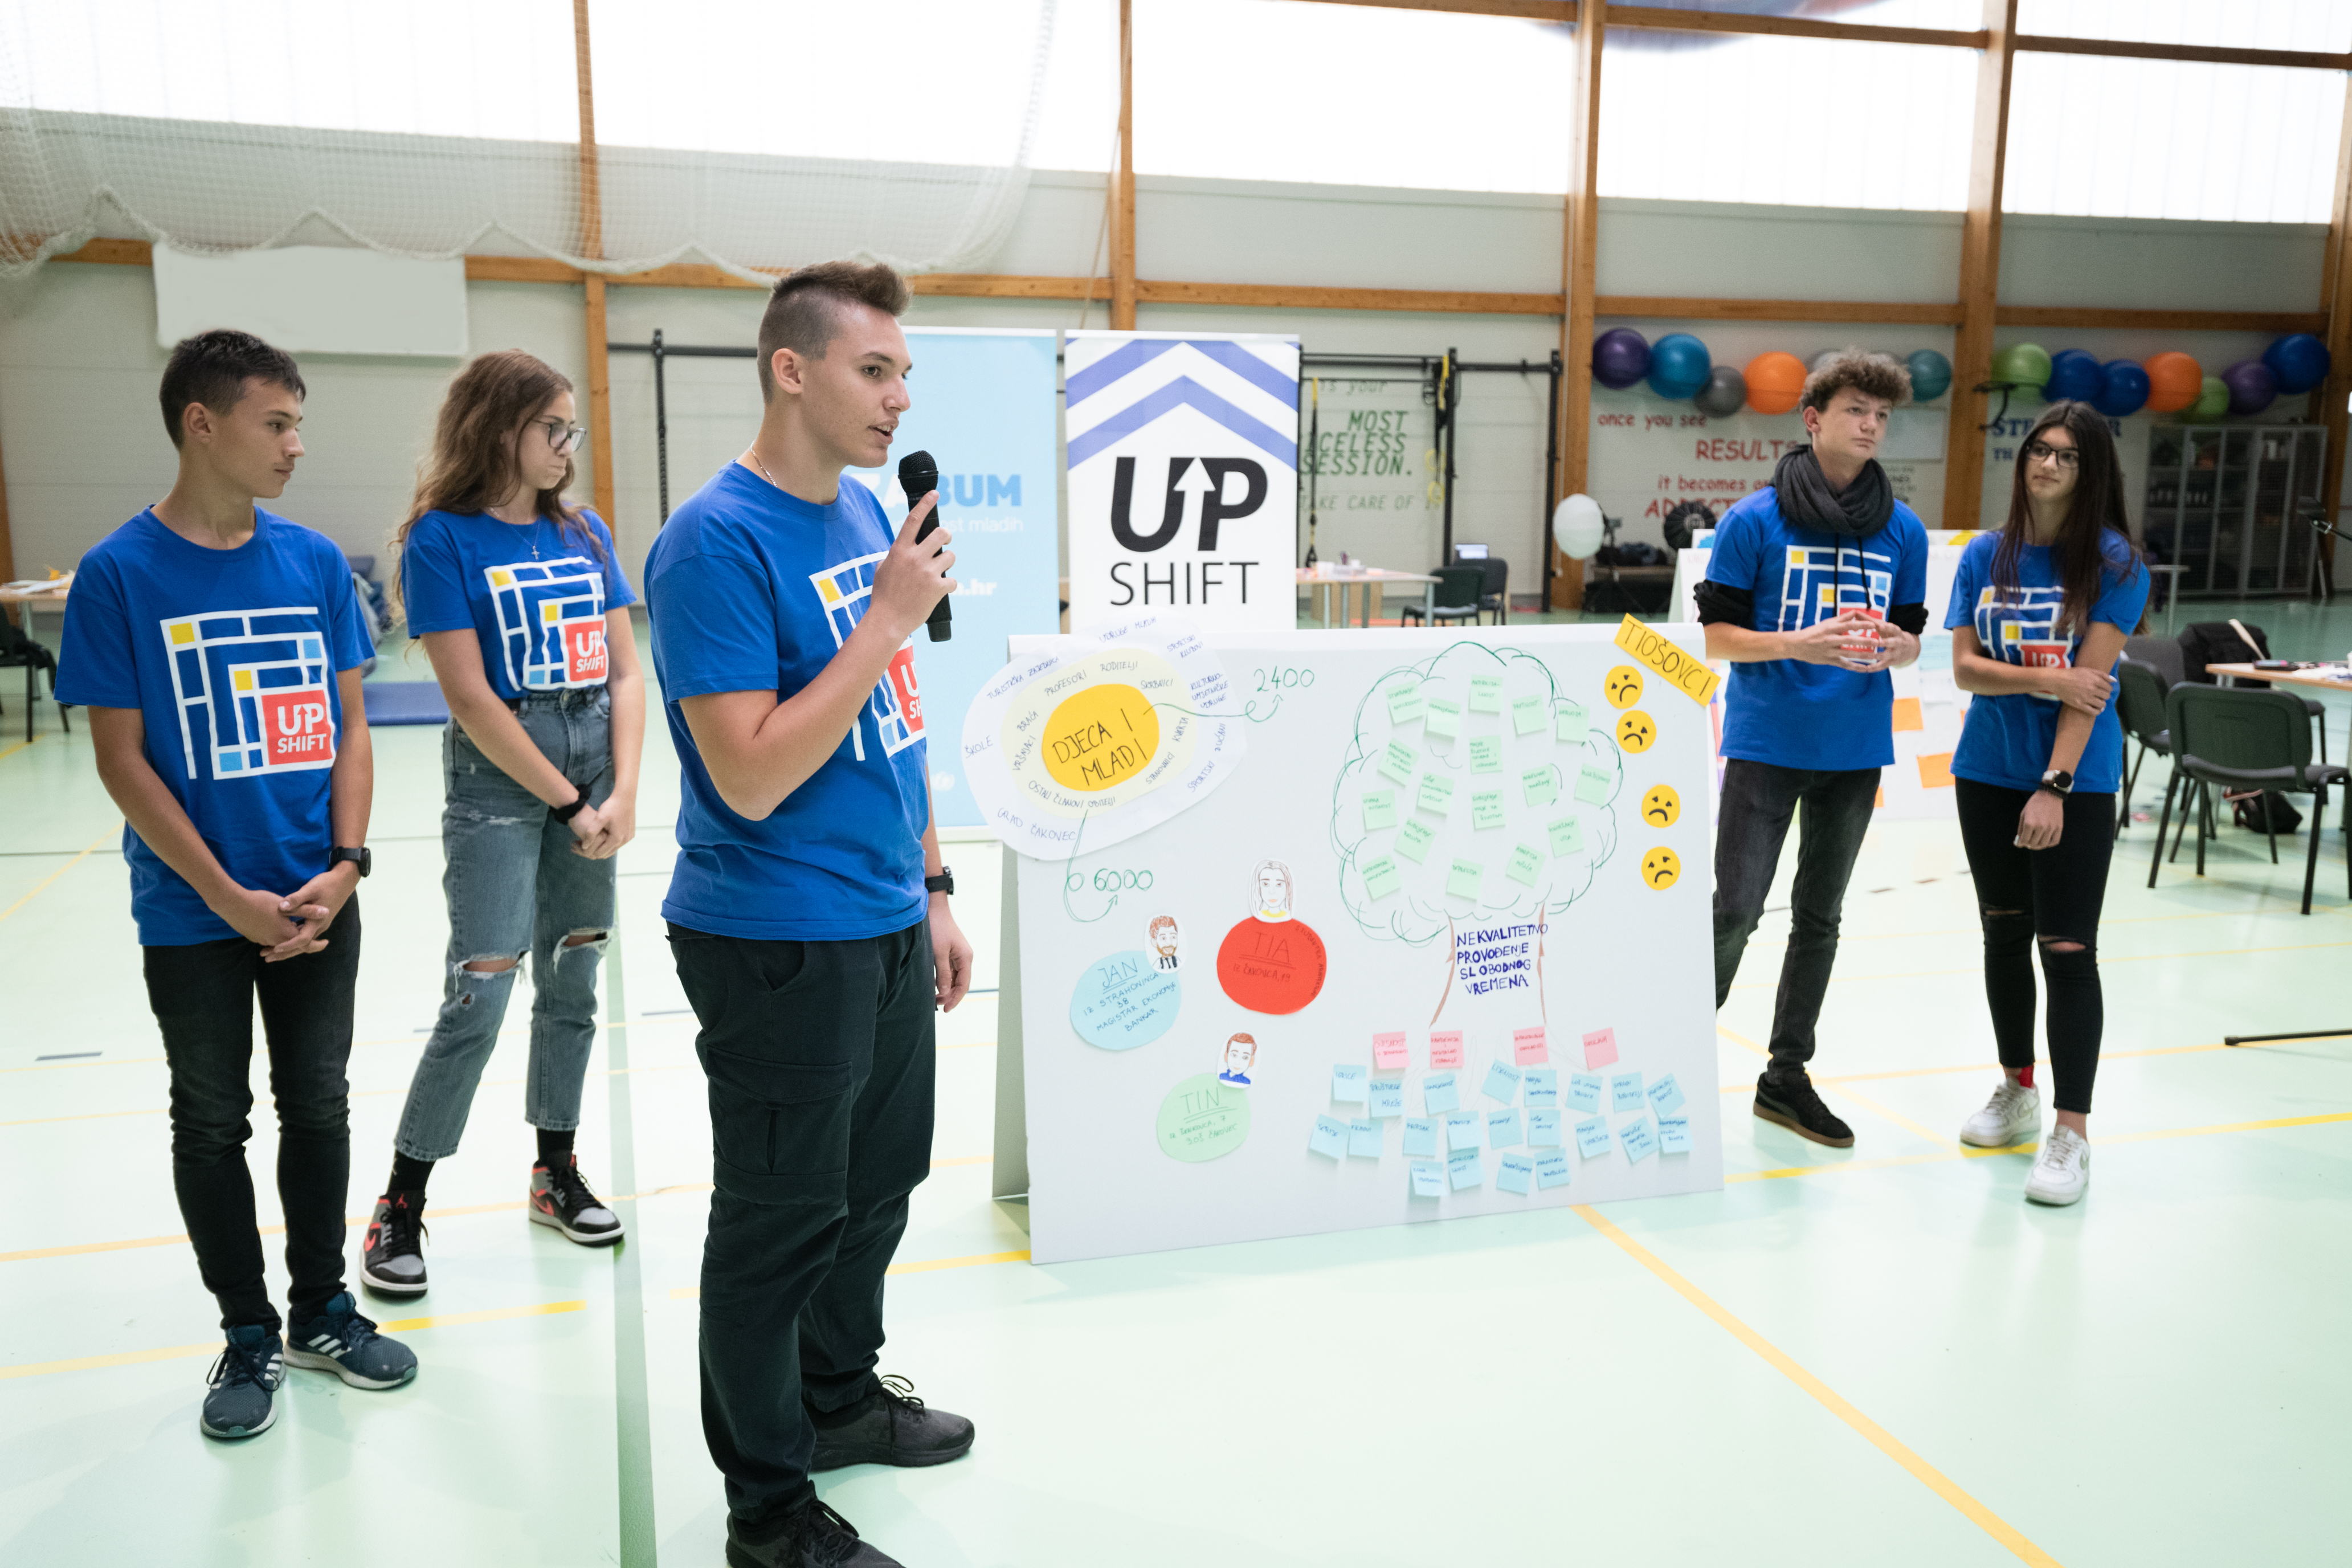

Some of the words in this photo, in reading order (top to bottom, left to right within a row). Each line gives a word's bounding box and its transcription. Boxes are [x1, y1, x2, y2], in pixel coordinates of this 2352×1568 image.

[1348, 410, 1410, 431] MOST
[1598, 414, 1635, 427] once
[1644, 414, 1673, 431] you
[1681, 414, 1707, 427] see
[1657, 475, 1671, 491] it
[1677, 475, 1746, 492] becomes
[1110, 456, 1268, 552] UP
[1348, 495, 1387, 511] CARE
[1394, 495, 1414, 511] OF
[1110, 561, 1260, 606] SHIFT
[576, 630, 602, 658] UP
[1099, 626, 1128, 643] UDRUGE
[576, 655, 605, 673] SHIFT
[1028, 656, 1060, 677] ZAJEDNICA
[1100, 660, 1138, 672] RODITELJI
[1625, 620, 1711, 696] TIOŠOVCI
[1044, 669, 1087, 696] PROFESORI
[1141, 678, 1173, 689] SKRBNICI
[1254, 665, 1314, 693] 2400
[1200, 692, 1227, 709] UDRUGE
[277, 703, 324, 736] UP
[1017, 710, 1039, 732] BRAĆA
[277, 733, 326, 754] SHIFT
[965, 735, 994, 758] ŠKOLE
[1012, 735, 1036, 771] VRŠNJACI
[1052, 720, 1113, 763] DJECA
[1146, 752, 1175, 785] STANOVNICI
[1172, 717, 1189, 742] KVARTA
[1081, 738, 1147, 786] MLADI
[1187, 760, 1215, 793] SPORTSKI
[1054, 793, 1084, 808] ČLANOVI
[1088, 797, 1116, 807] OBITELJI
[998, 807, 1023, 827] GRAD
[1031, 823, 1076, 841] ČAKOVEC
[1094, 868, 1153, 892] 6000
[1256, 931, 1290, 963] TIA
[1456, 924, 1548, 947] NEKVALITETNO
[1097, 958, 1138, 988] JAN
[1460, 959, 1531, 980] SLOBODNOG
[1100, 972, 1159, 1007] STRAHONINCA
[1465, 974, 1529, 995] VREMENA
[1097, 1005, 1138, 1031] MAGISTAR
[1142, 981, 1177, 1006] EKONOMIJE
[1117, 997, 1129, 1008] 38
[1125, 1008, 1159, 1031] BANKAR
[1374, 1038, 1406, 1048] OVISNOST
[1492, 1064, 1521, 1083] LIJENOST
[1179, 1087, 1220, 1114] TIN
[1382, 1098, 1402, 1107] MREŽE
[1318, 1124, 1338, 1137] SERIJE
